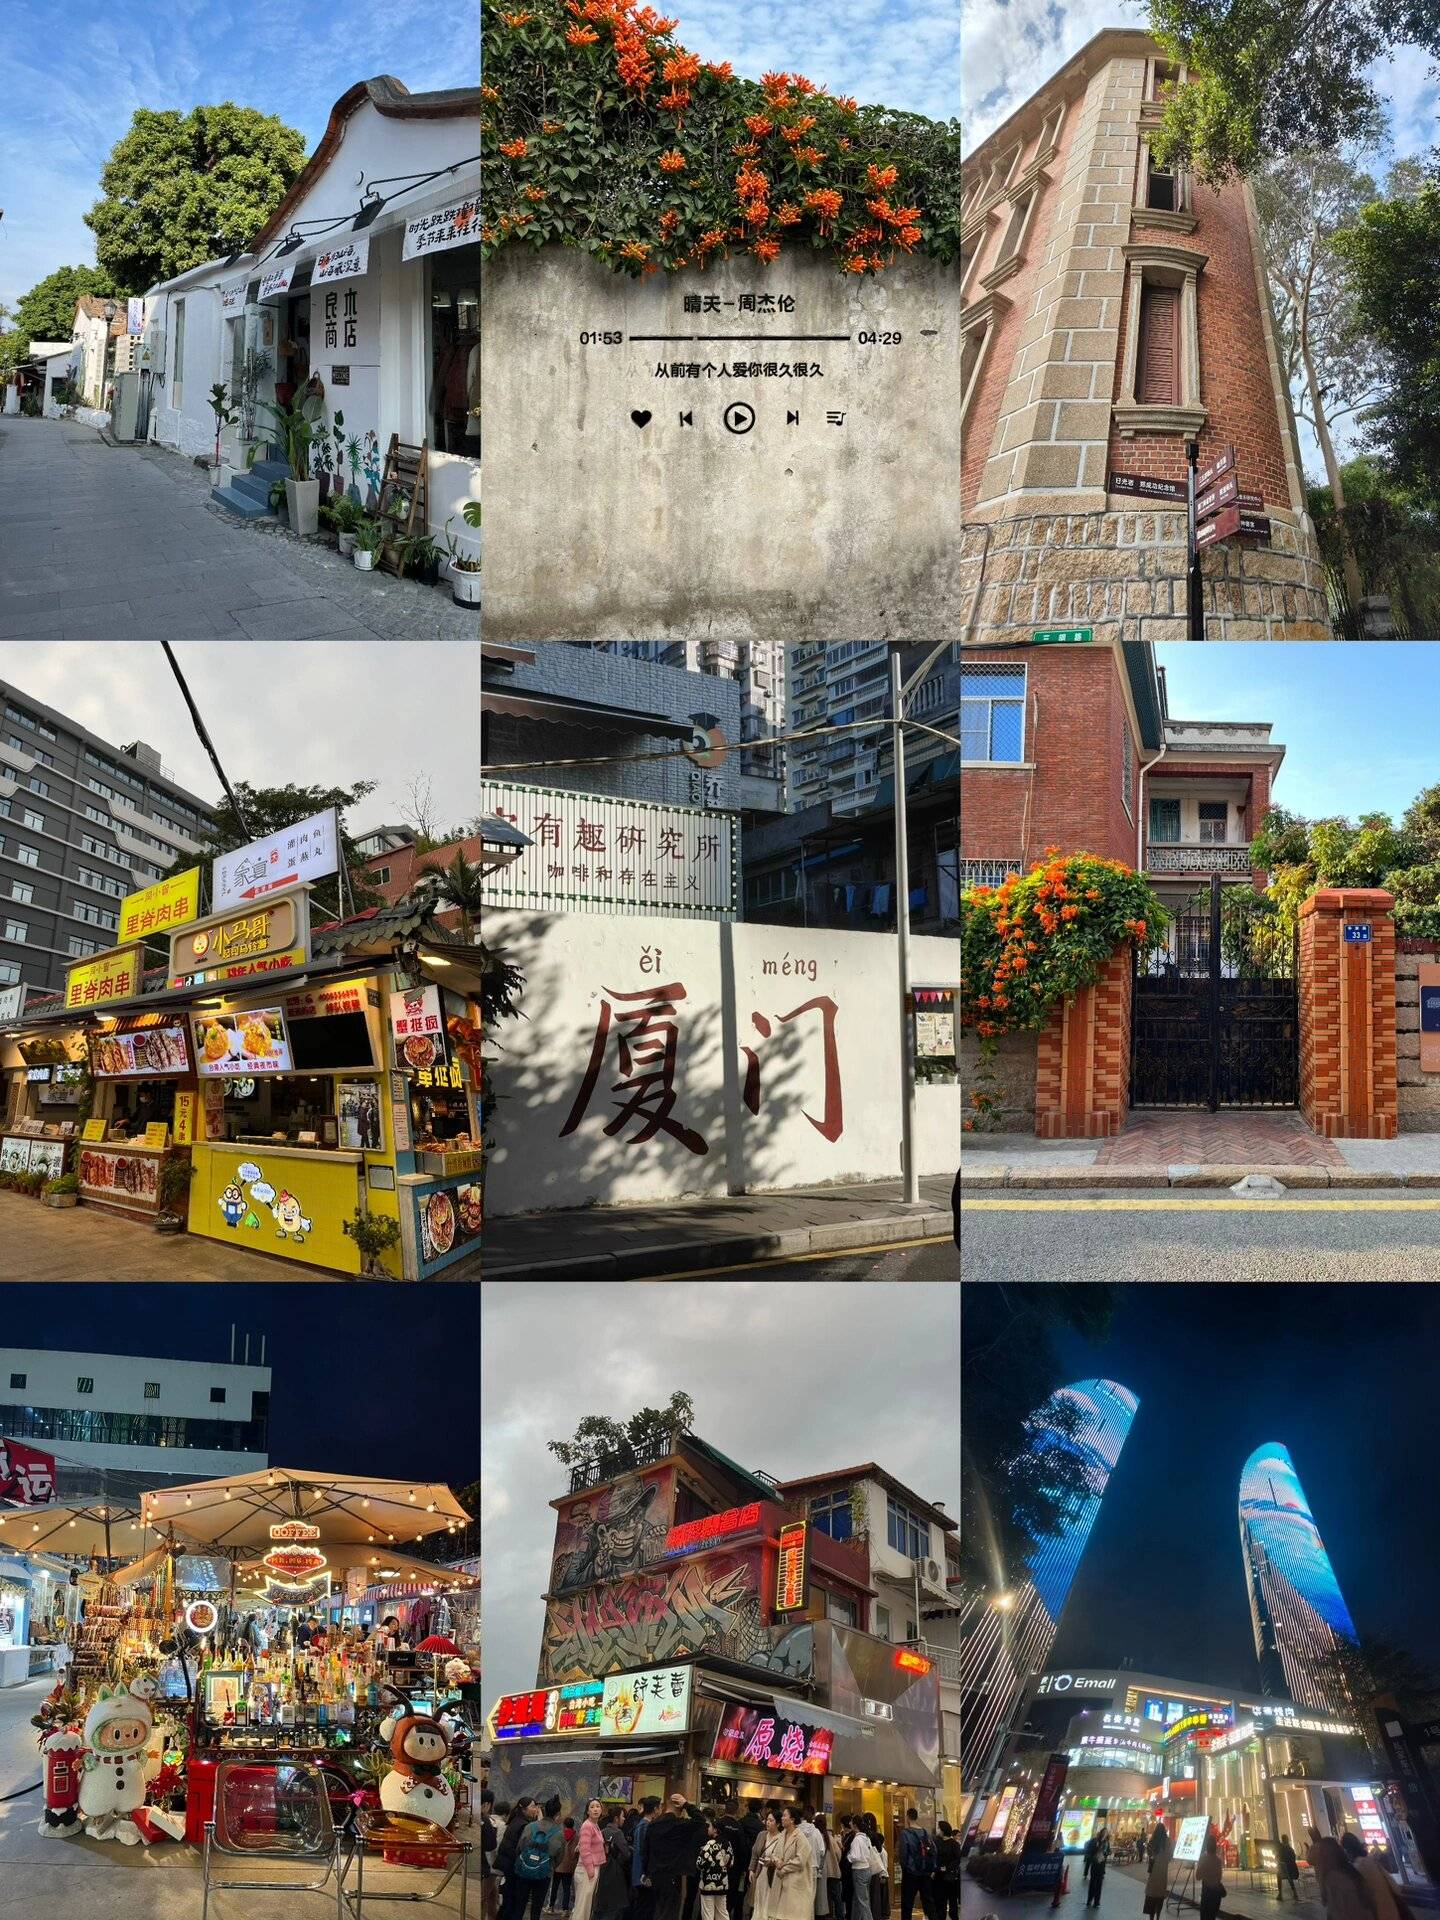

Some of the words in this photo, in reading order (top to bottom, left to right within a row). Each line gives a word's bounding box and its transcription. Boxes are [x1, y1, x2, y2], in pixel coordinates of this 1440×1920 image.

[579, 331, 623, 345] 01:53
[858, 331, 902, 345] 04:29
[655, 362, 824, 379] 从前有个人爱你很久很久
[495, 806, 722, 864] 有趣研究所
[125, 896, 189, 936] 里脊肉串
[213, 913, 271, 957] 小马哥
[1352, 931, 1361, 939] 33
[762, 952, 818, 982] méng
[69, 970, 130, 1007] 里脊肉串
[559, 982, 844, 1156] 厦门
[273, 1528, 317, 1538] COFFEE
[633, 1672, 686, 1703] 舒芙蕾
[1074, 1677, 1117, 1689] Emall
[744, 1718, 805, 1767] 原烧
[706, 1873, 721, 1881] AQY
